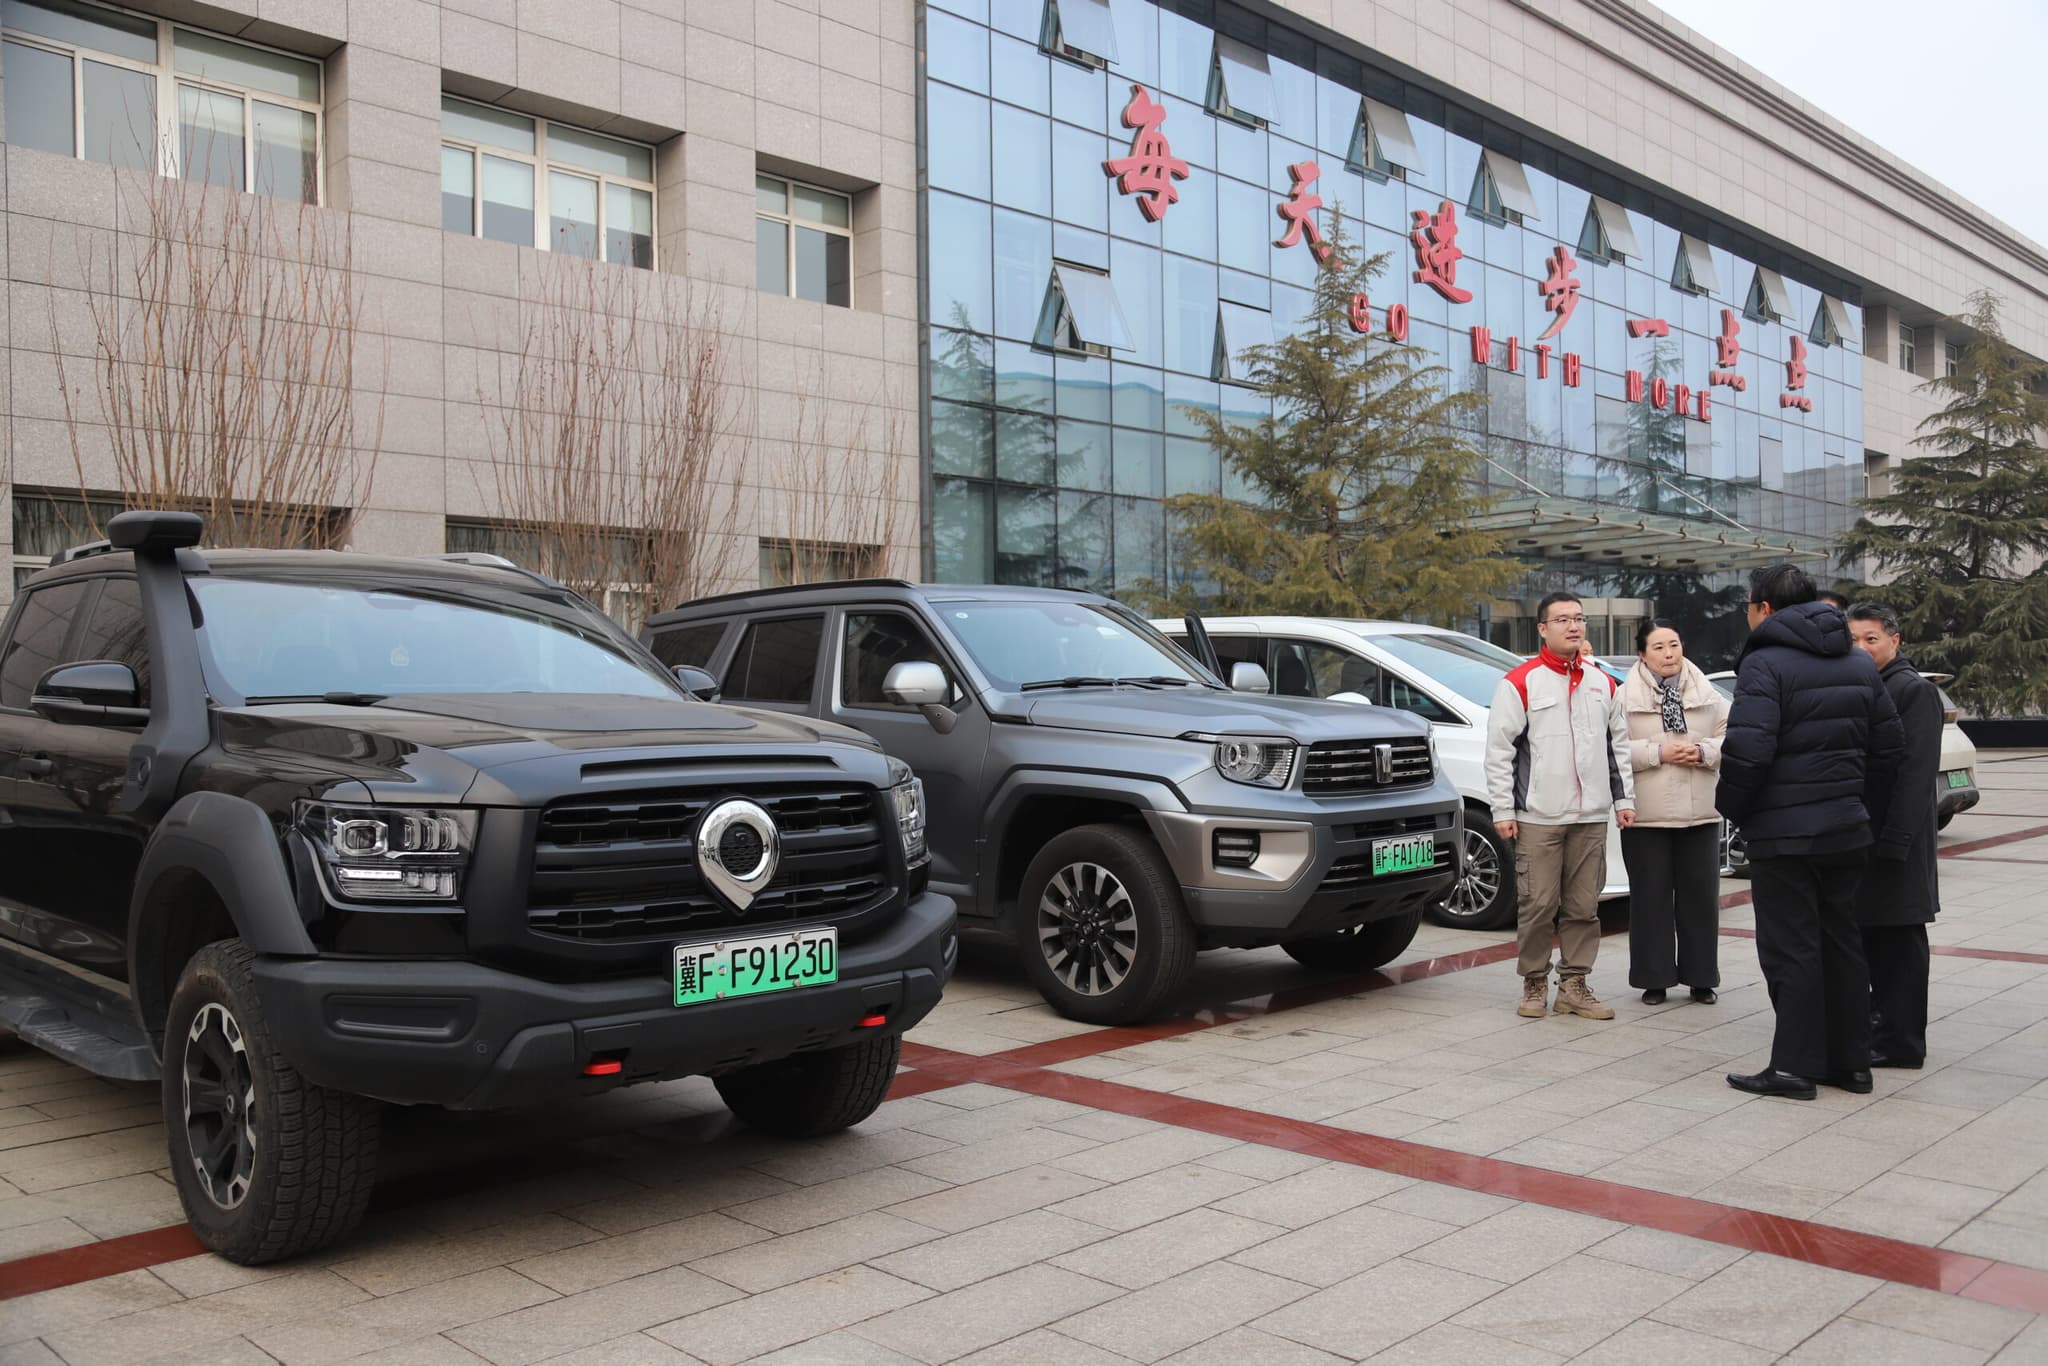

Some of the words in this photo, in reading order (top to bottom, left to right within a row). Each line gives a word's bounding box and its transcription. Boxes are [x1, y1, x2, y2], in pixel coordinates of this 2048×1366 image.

[1349, 292, 1408, 341] GO
[1470, 326, 1581, 387] WITH
[1626, 370, 1712, 421] MORE
